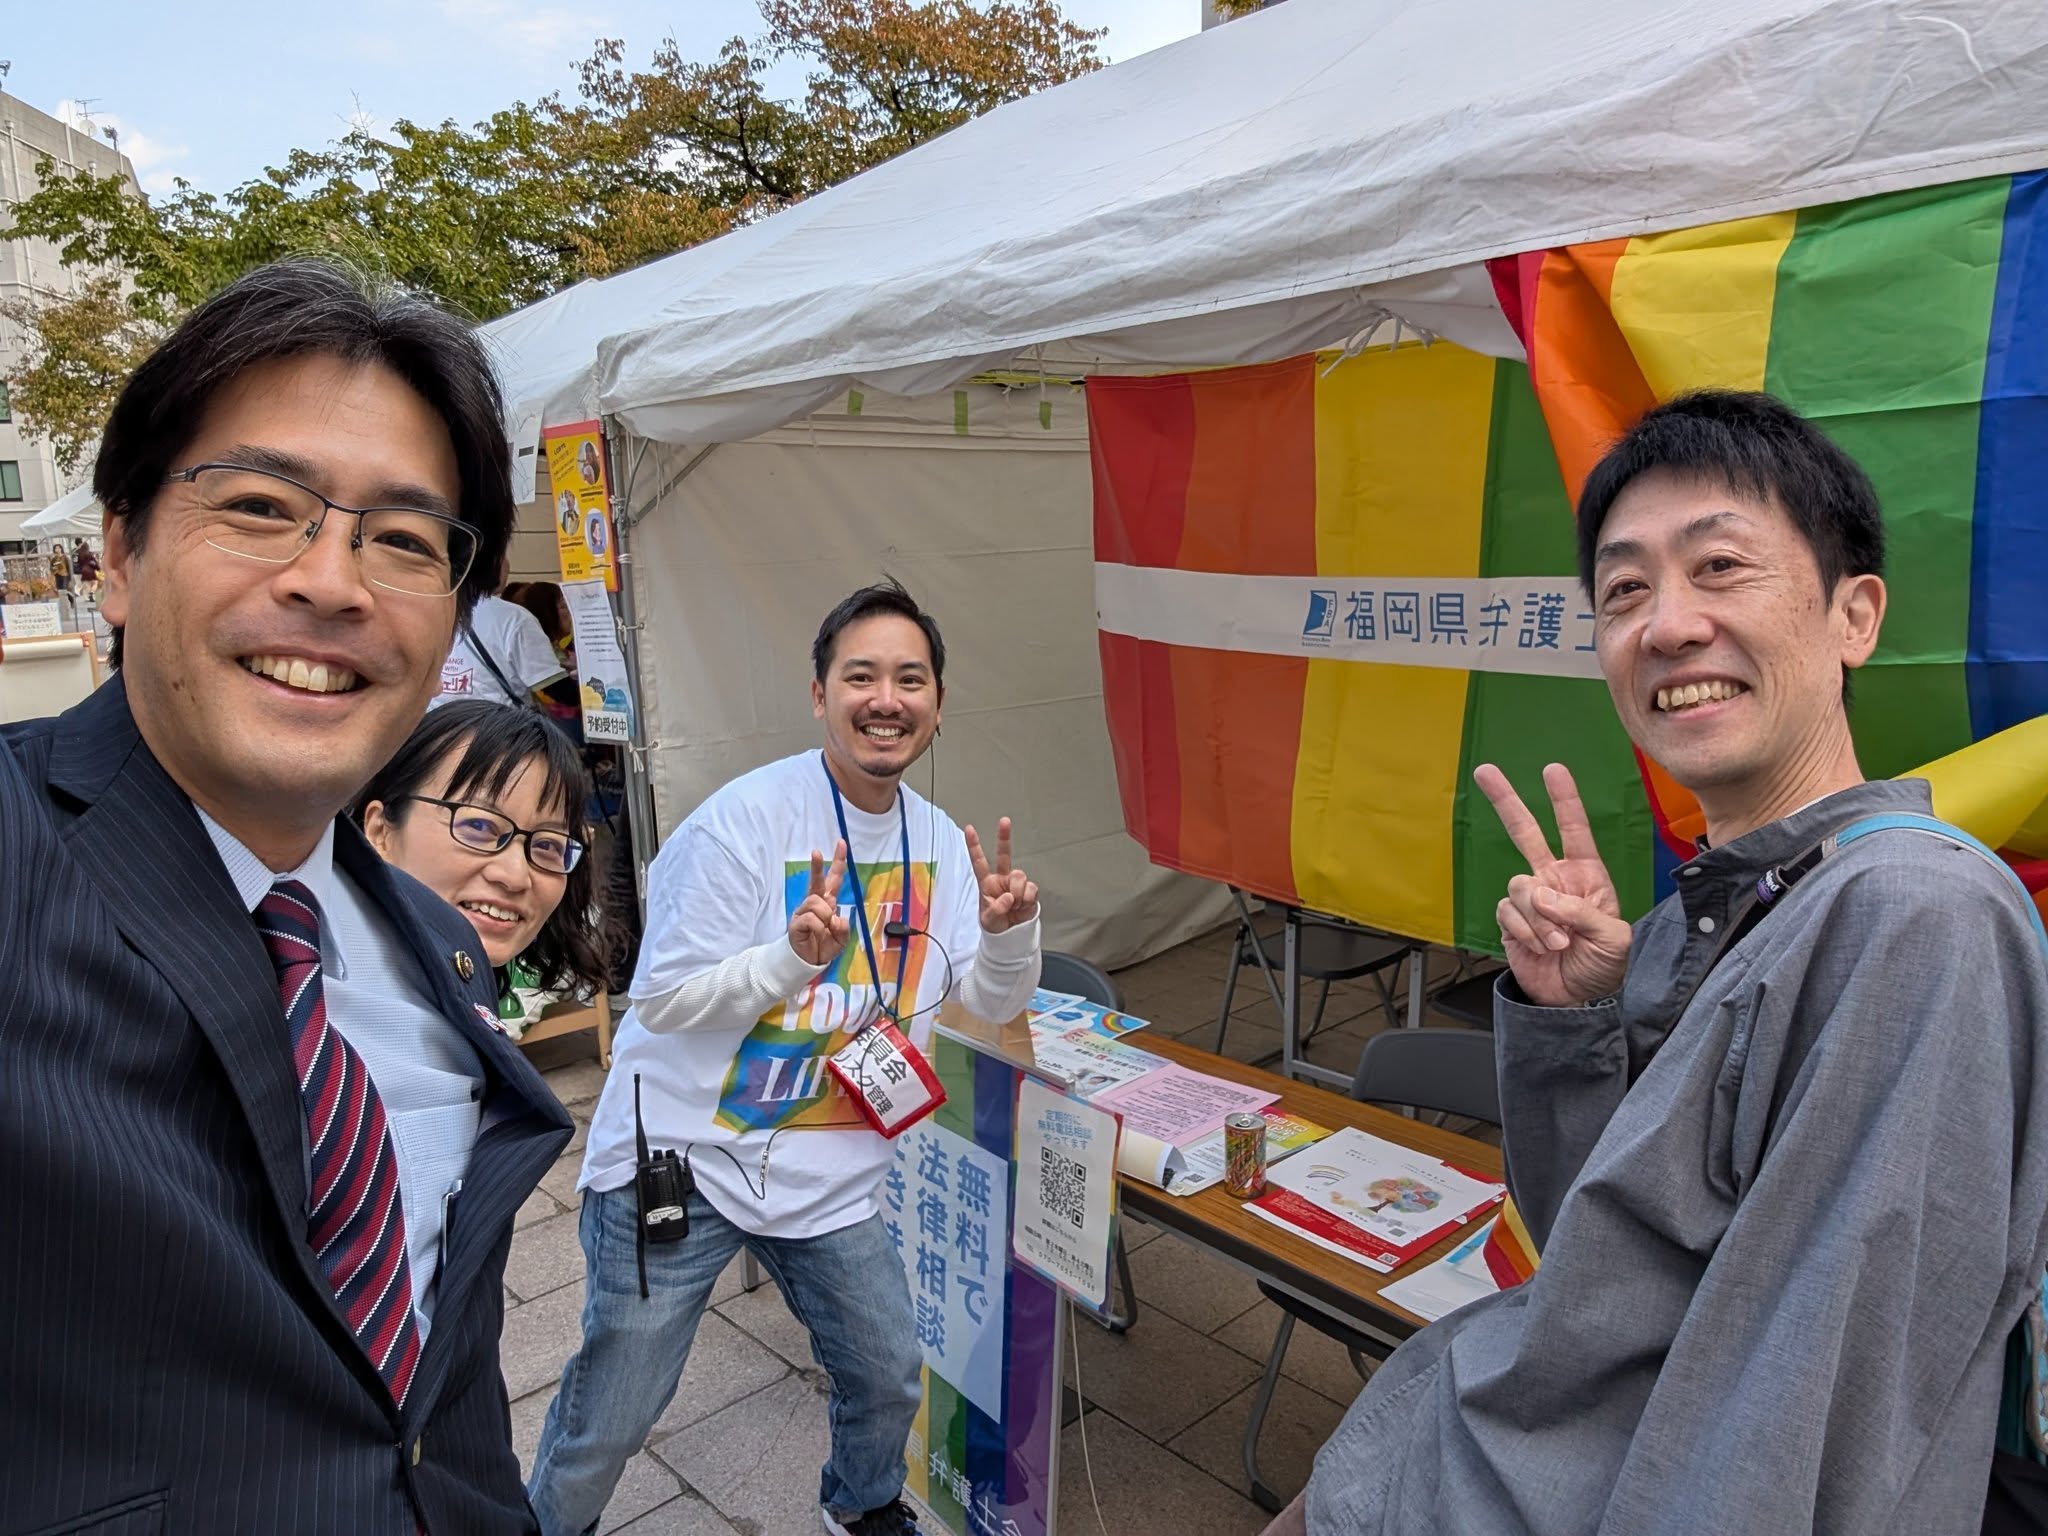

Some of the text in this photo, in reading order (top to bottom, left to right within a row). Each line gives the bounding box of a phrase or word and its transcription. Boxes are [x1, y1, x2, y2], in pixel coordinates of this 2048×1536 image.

[586, 715, 627, 736] 予約受付中
[833, 1047, 894, 1117] リスク管理
[1045, 1109, 1082, 1126] 定期的に
[1037, 1119, 1094, 1141] 無料電話相談
[1043, 1132, 1089, 1151] やってます
[915, 1131, 950, 1358] 法律相談
[955, 1153, 991, 1327] 無料で
